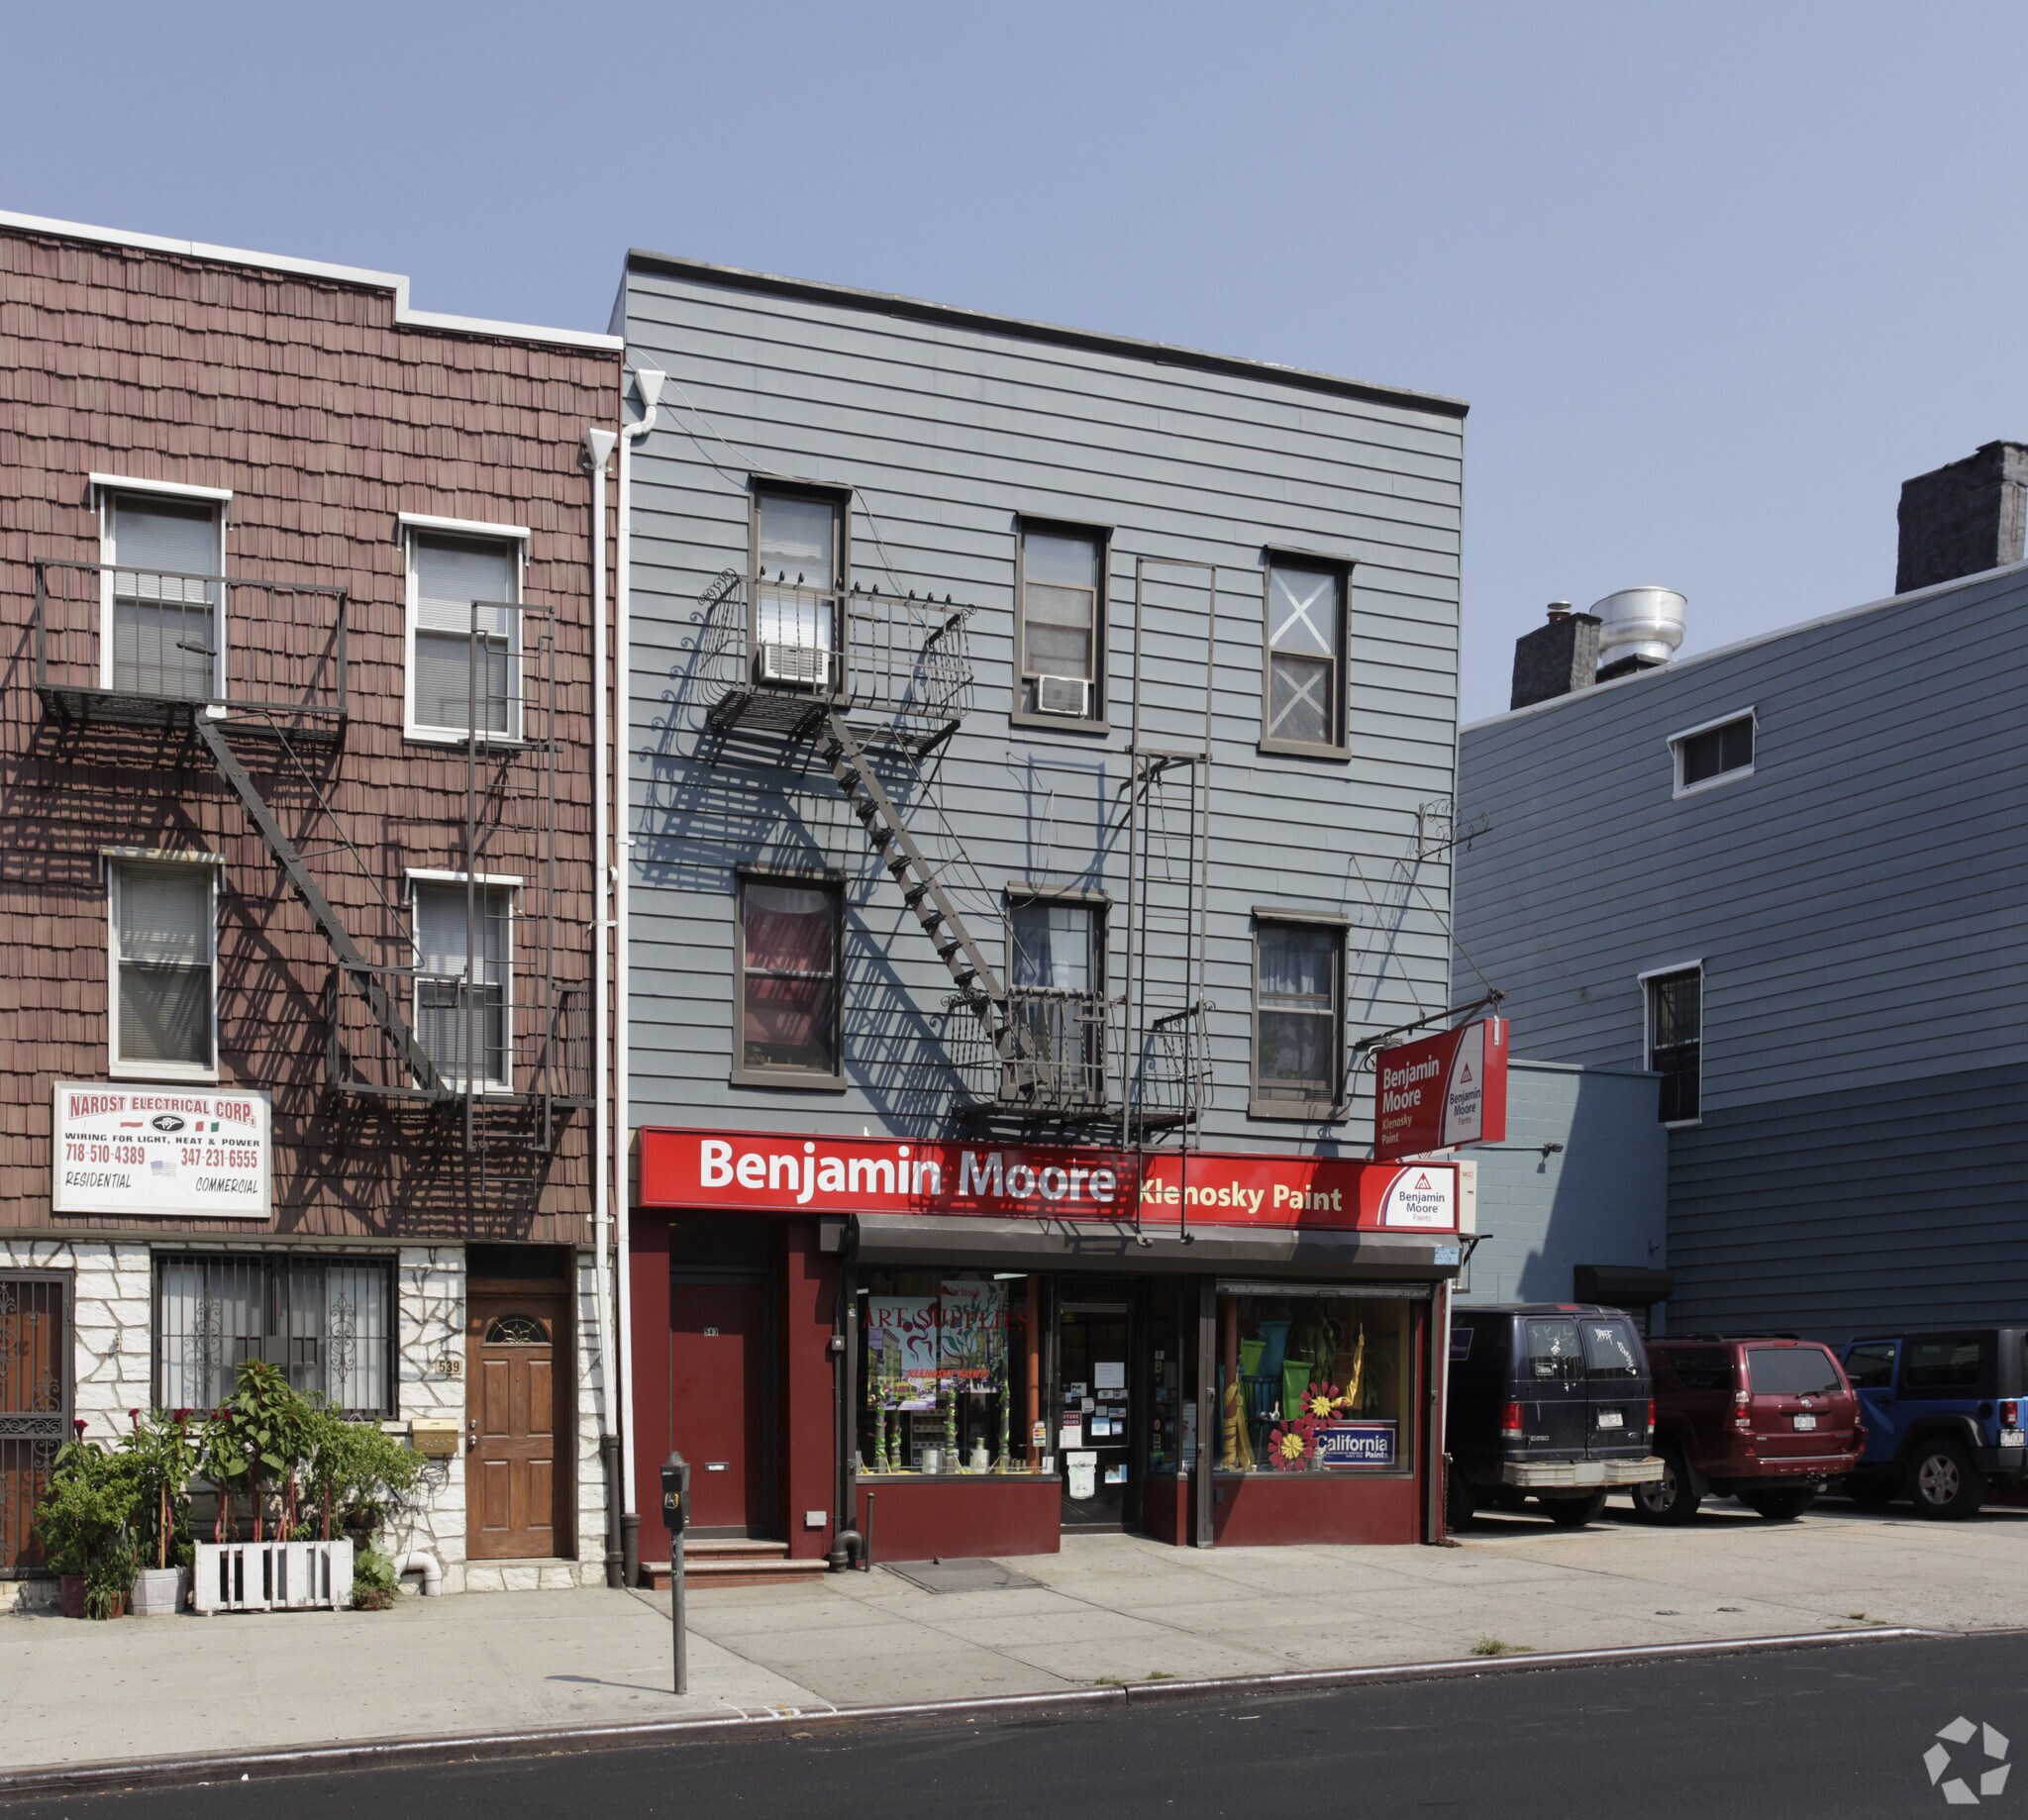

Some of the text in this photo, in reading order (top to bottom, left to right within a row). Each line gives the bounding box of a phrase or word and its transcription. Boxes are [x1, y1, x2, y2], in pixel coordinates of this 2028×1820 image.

[1383, 1055, 1440, 1090] Benjamin
[1382, 1088, 1421, 1114] Moore
[1450, 1087, 1481, 1105] Benjamin
[69, 1094, 256, 1127] NAROST ELECTRICAL CORP.
[1454, 1103, 1476, 1117] Moore
[1382, 1114, 1413, 1130] Klenosky
[1458, 1116, 1471, 1126] Paints
[65, 1133, 108, 1142] WIRING
[138, 1136, 170, 1145] LIGHT,
[222, 1139, 260, 1148] POWER
[1382, 1133, 1399, 1145] Paint
[65, 1143, 146, 1164] 718-510-4389
[181, 1148, 257, 1167] 347-231-6555
[65, 1171, 132, 1188] RESIDENTIAL
[700, 1140, 1117, 1204] Benjamin Moore
[195, 1176, 258, 1194] COMMERCIAL
[1141, 1179, 1343, 1213] Klenosky Paint
[1399, 1191, 1445, 1204] Benjamin
[1406, 1203, 1439, 1213] Moore
[862, 1306, 1031, 1331] ART SUPPLIES
[439, 1361, 459, 1372] 539
[1318, 1435, 1388, 1451] California
